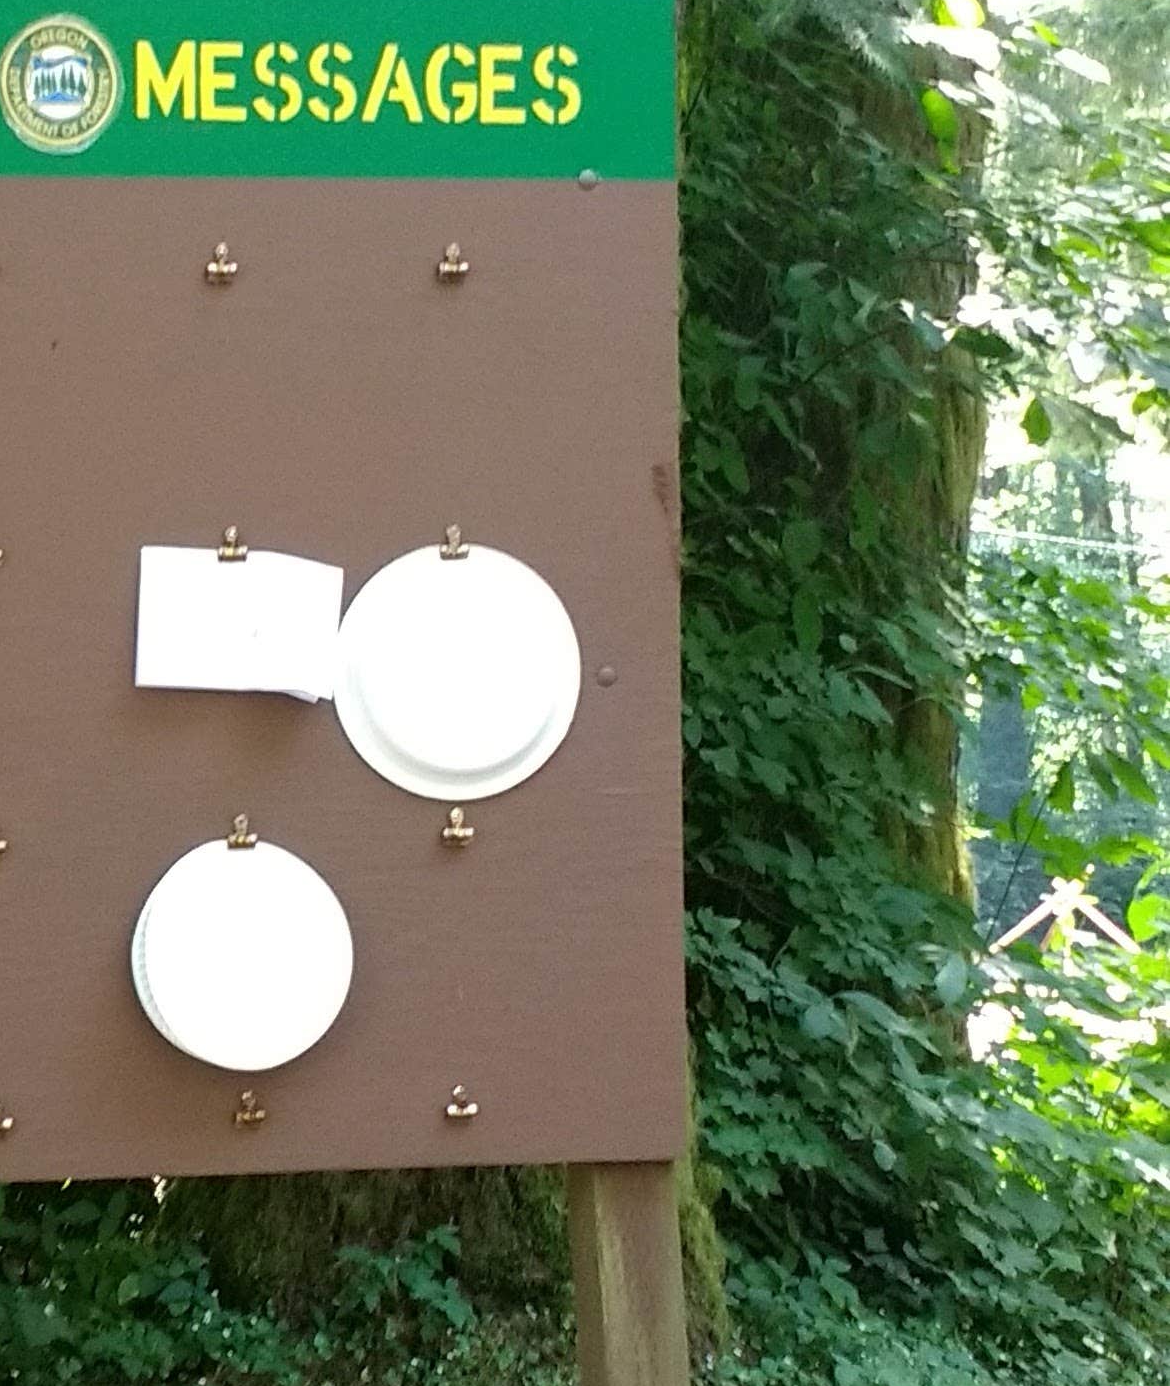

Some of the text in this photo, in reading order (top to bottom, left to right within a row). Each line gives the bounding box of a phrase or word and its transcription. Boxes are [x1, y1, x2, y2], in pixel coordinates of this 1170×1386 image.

[30, 27, 88, 50] OREGON
[135, 39, 582, 126] MESSAGES
[61, 124, 79, 137] OF
